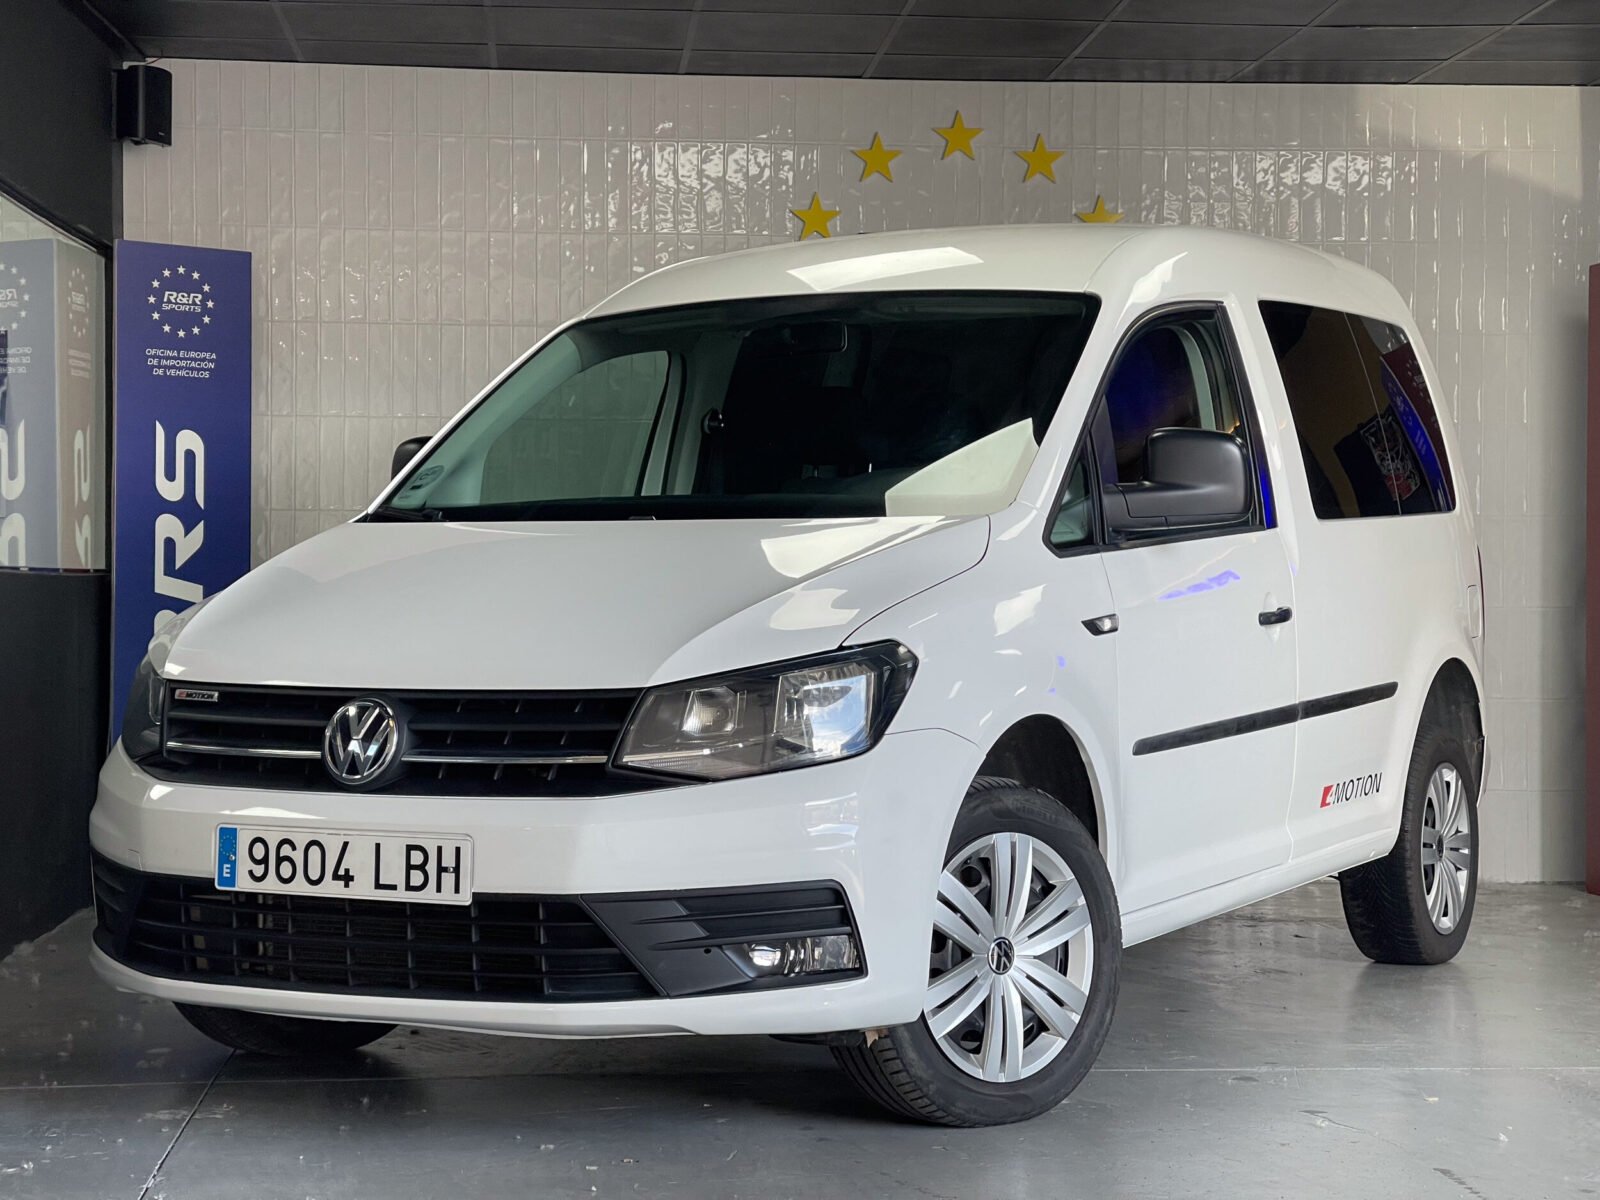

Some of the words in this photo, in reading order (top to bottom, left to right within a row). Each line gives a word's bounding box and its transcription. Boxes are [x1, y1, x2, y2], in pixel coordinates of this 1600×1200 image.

[163, 291, 203, 305] R&R
[162, 303, 202, 312] SPORTS
[145, 348, 178, 357] OFICINA
[180, 350, 217, 360] EUROPEA
[147, 358, 159, 366] DE
[160, 359, 215, 369] IMPORTACIÓN
[153, 368, 164, 376] DE
[166, 368, 210, 378] VEHÍCULOS
[154, 420, 205, 634] RS
[223, 863, 231, 877] E
[247, 836, 355, 889] 9604
[373, 842, 461, 895] LBH
